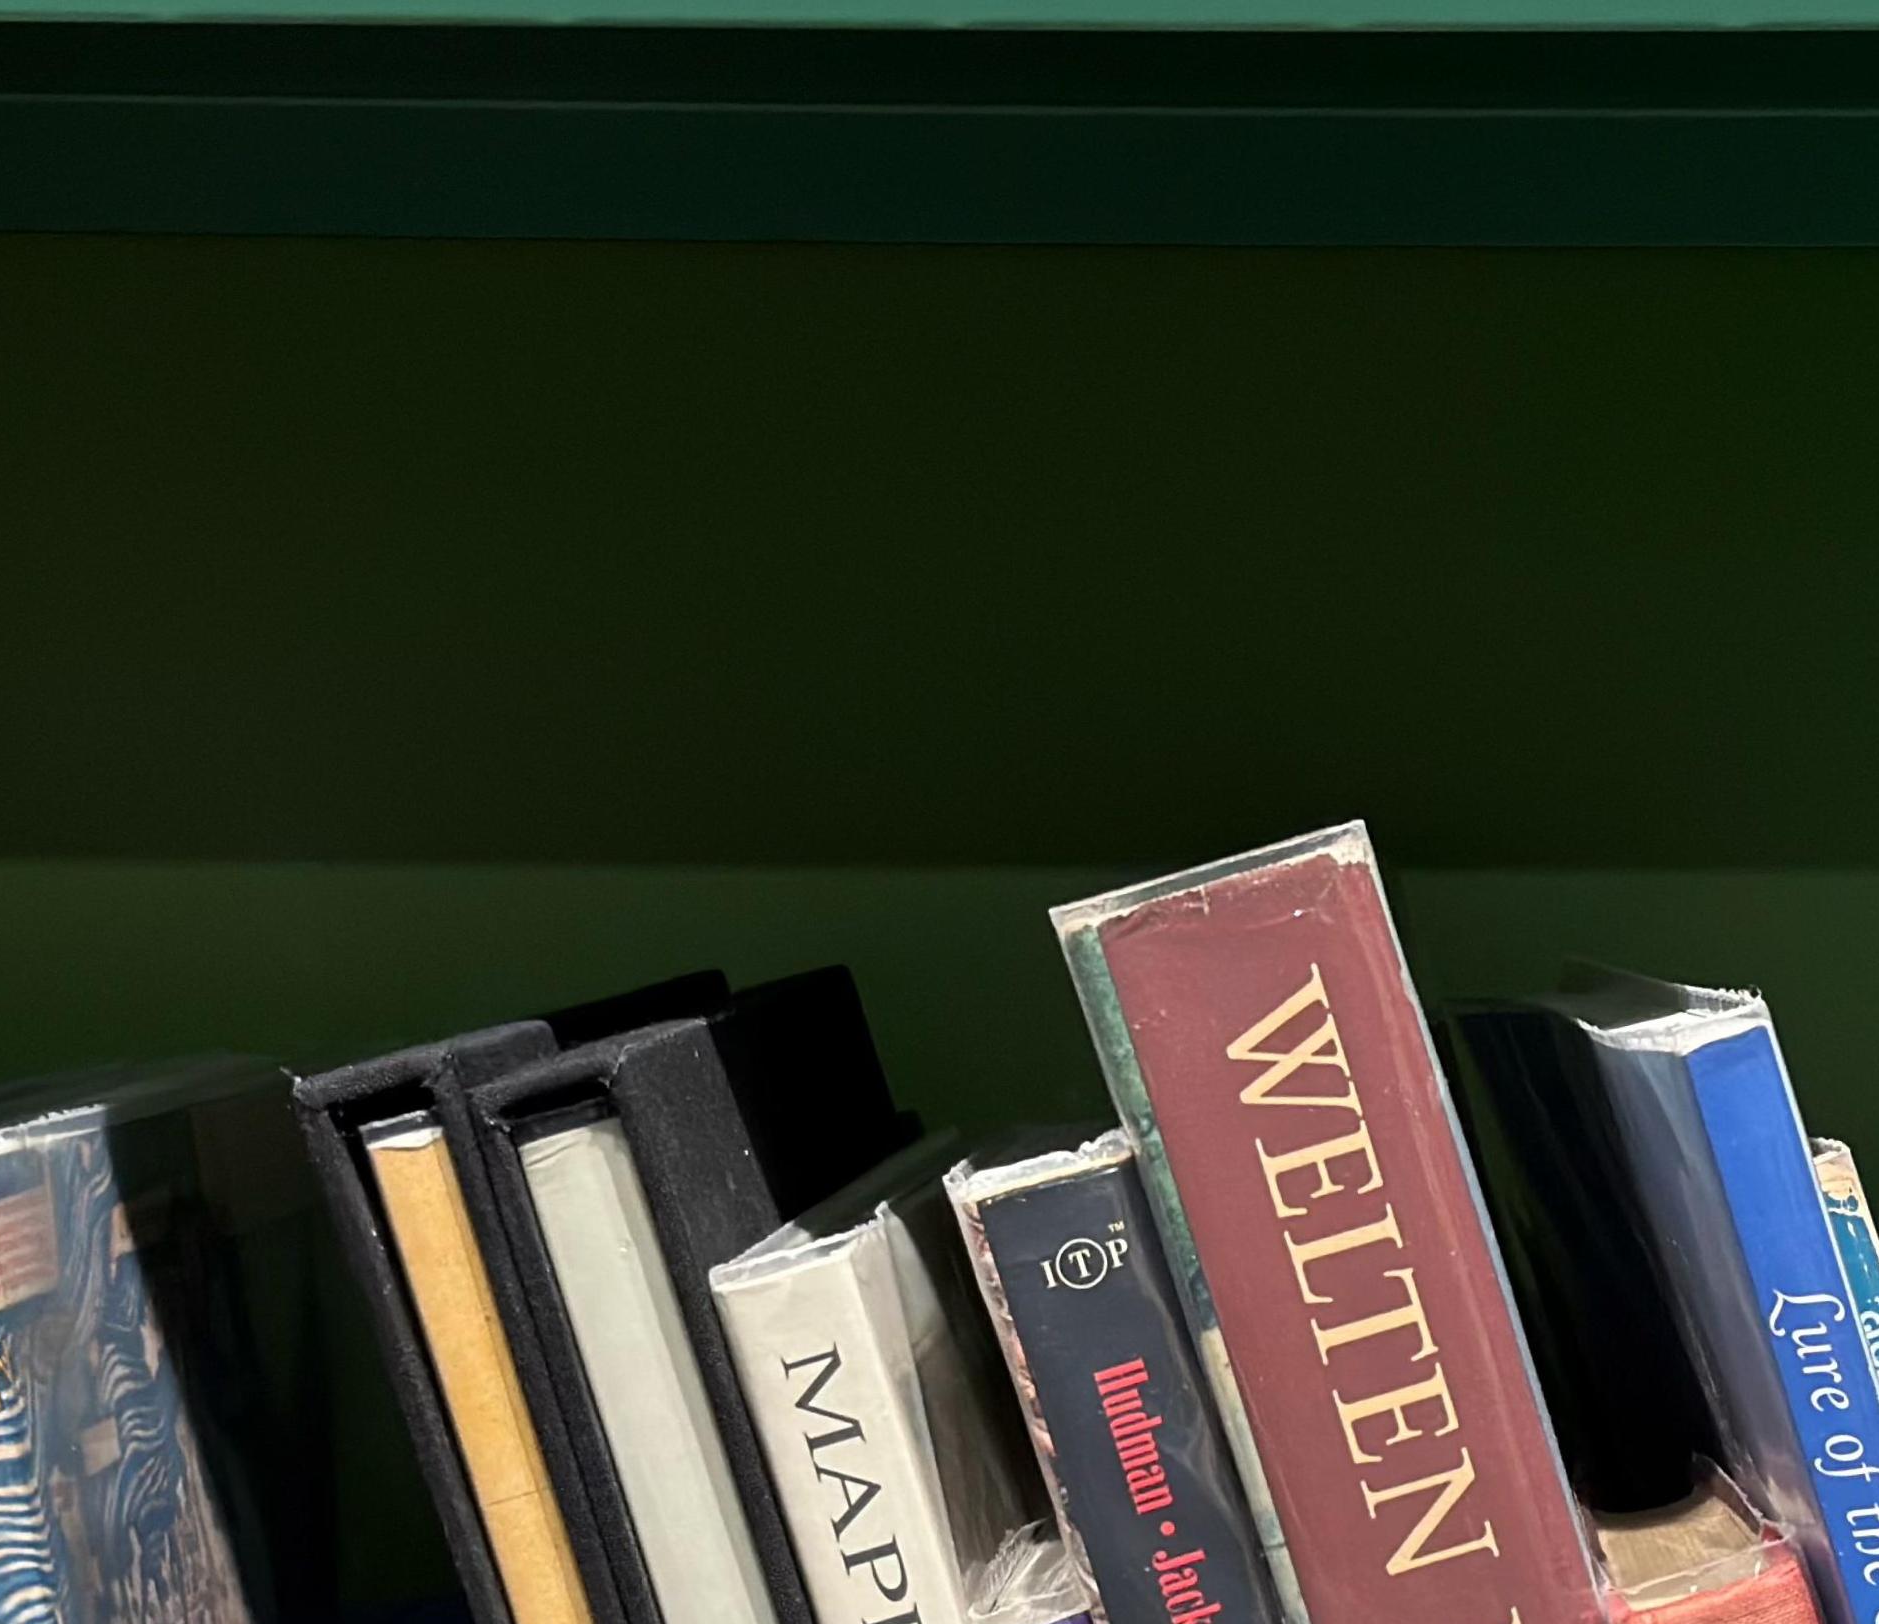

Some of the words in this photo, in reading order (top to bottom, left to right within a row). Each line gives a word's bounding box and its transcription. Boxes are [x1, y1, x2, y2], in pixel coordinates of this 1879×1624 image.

[1226, 963, 1500, 1576] WELTEN
[1768, 1289, 1850, 1412] Lure
[1093, 1358, 1176, 1516] Hudman
